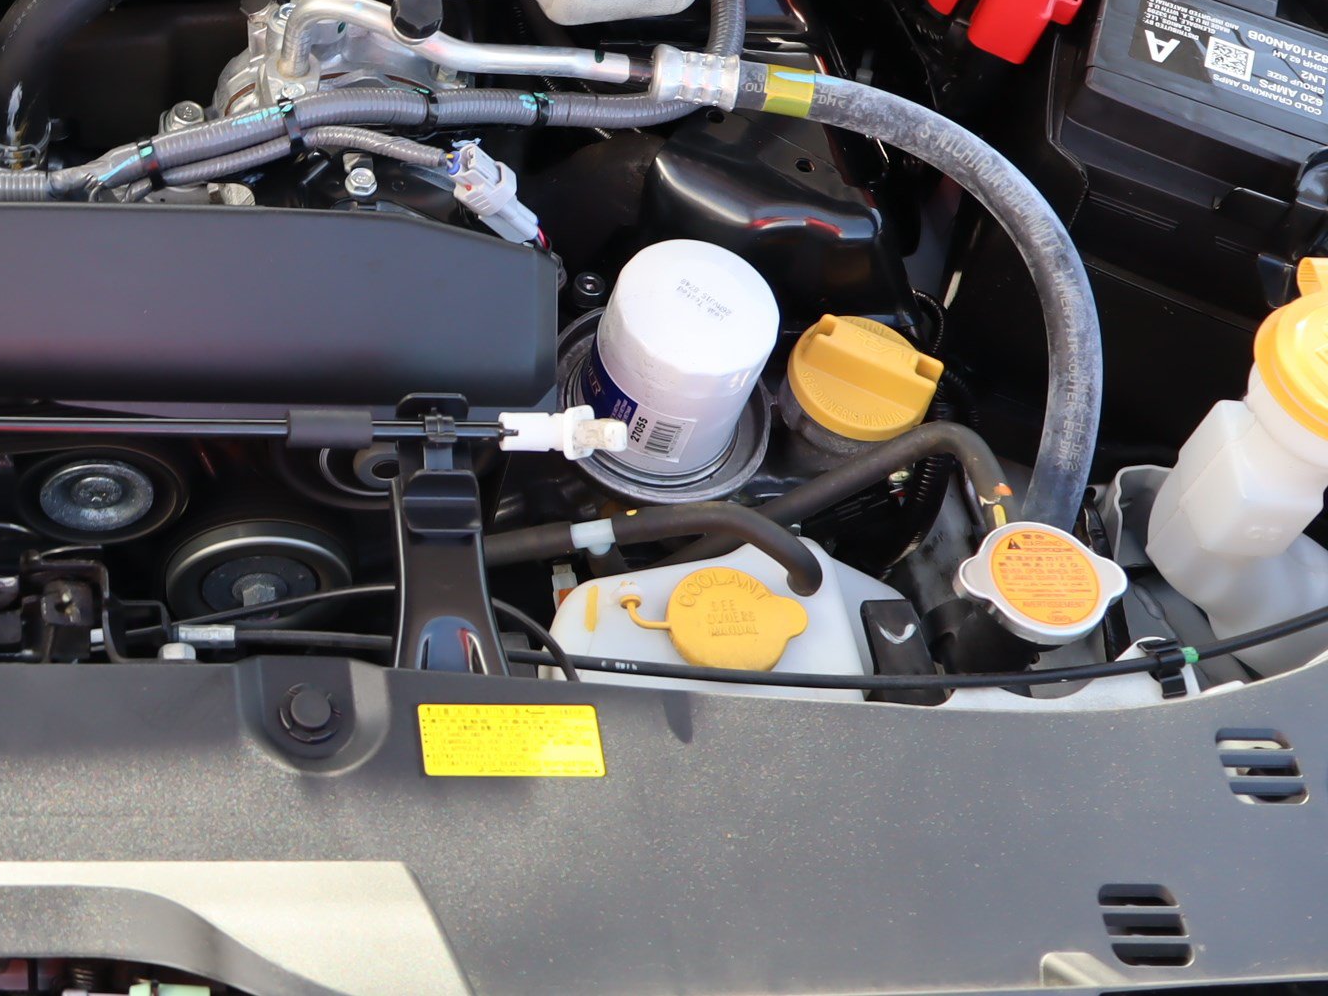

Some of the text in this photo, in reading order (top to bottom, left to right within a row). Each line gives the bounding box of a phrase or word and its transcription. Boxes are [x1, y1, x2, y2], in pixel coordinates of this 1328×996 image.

[1162, 6, 1180, 18] WITH
[1168, 14, 1178, 22] WI
[1188, 8, 1224, 26] IMPORTED
[1156, 22, 1200, 40] DISTRIBUTED
[1201, 20, 1210, 28] IN
[1210, 24, 1230, 34] MADE
[1224, 22, 1240, 30] AND
[1144, 30, 1180, 63] A
[1289, 55, 1301, 64] 62
[1302, 60, 1328, 74] 20HR
[1266, 70, 1325, 95] GROUP SIZE
[1301, 70, 1327, 86] LN2
[1212, 73, 1322, 116] COLD CRANKING AMPS
[1258, 78, 1324, 107] 620 AMPS
[630, 416, 648, 442] 27055
[678, 571, 772, 607] COOLANT
[712, 599, 736, 612] SEE
[710, 624, 759, 636] MANUAL
